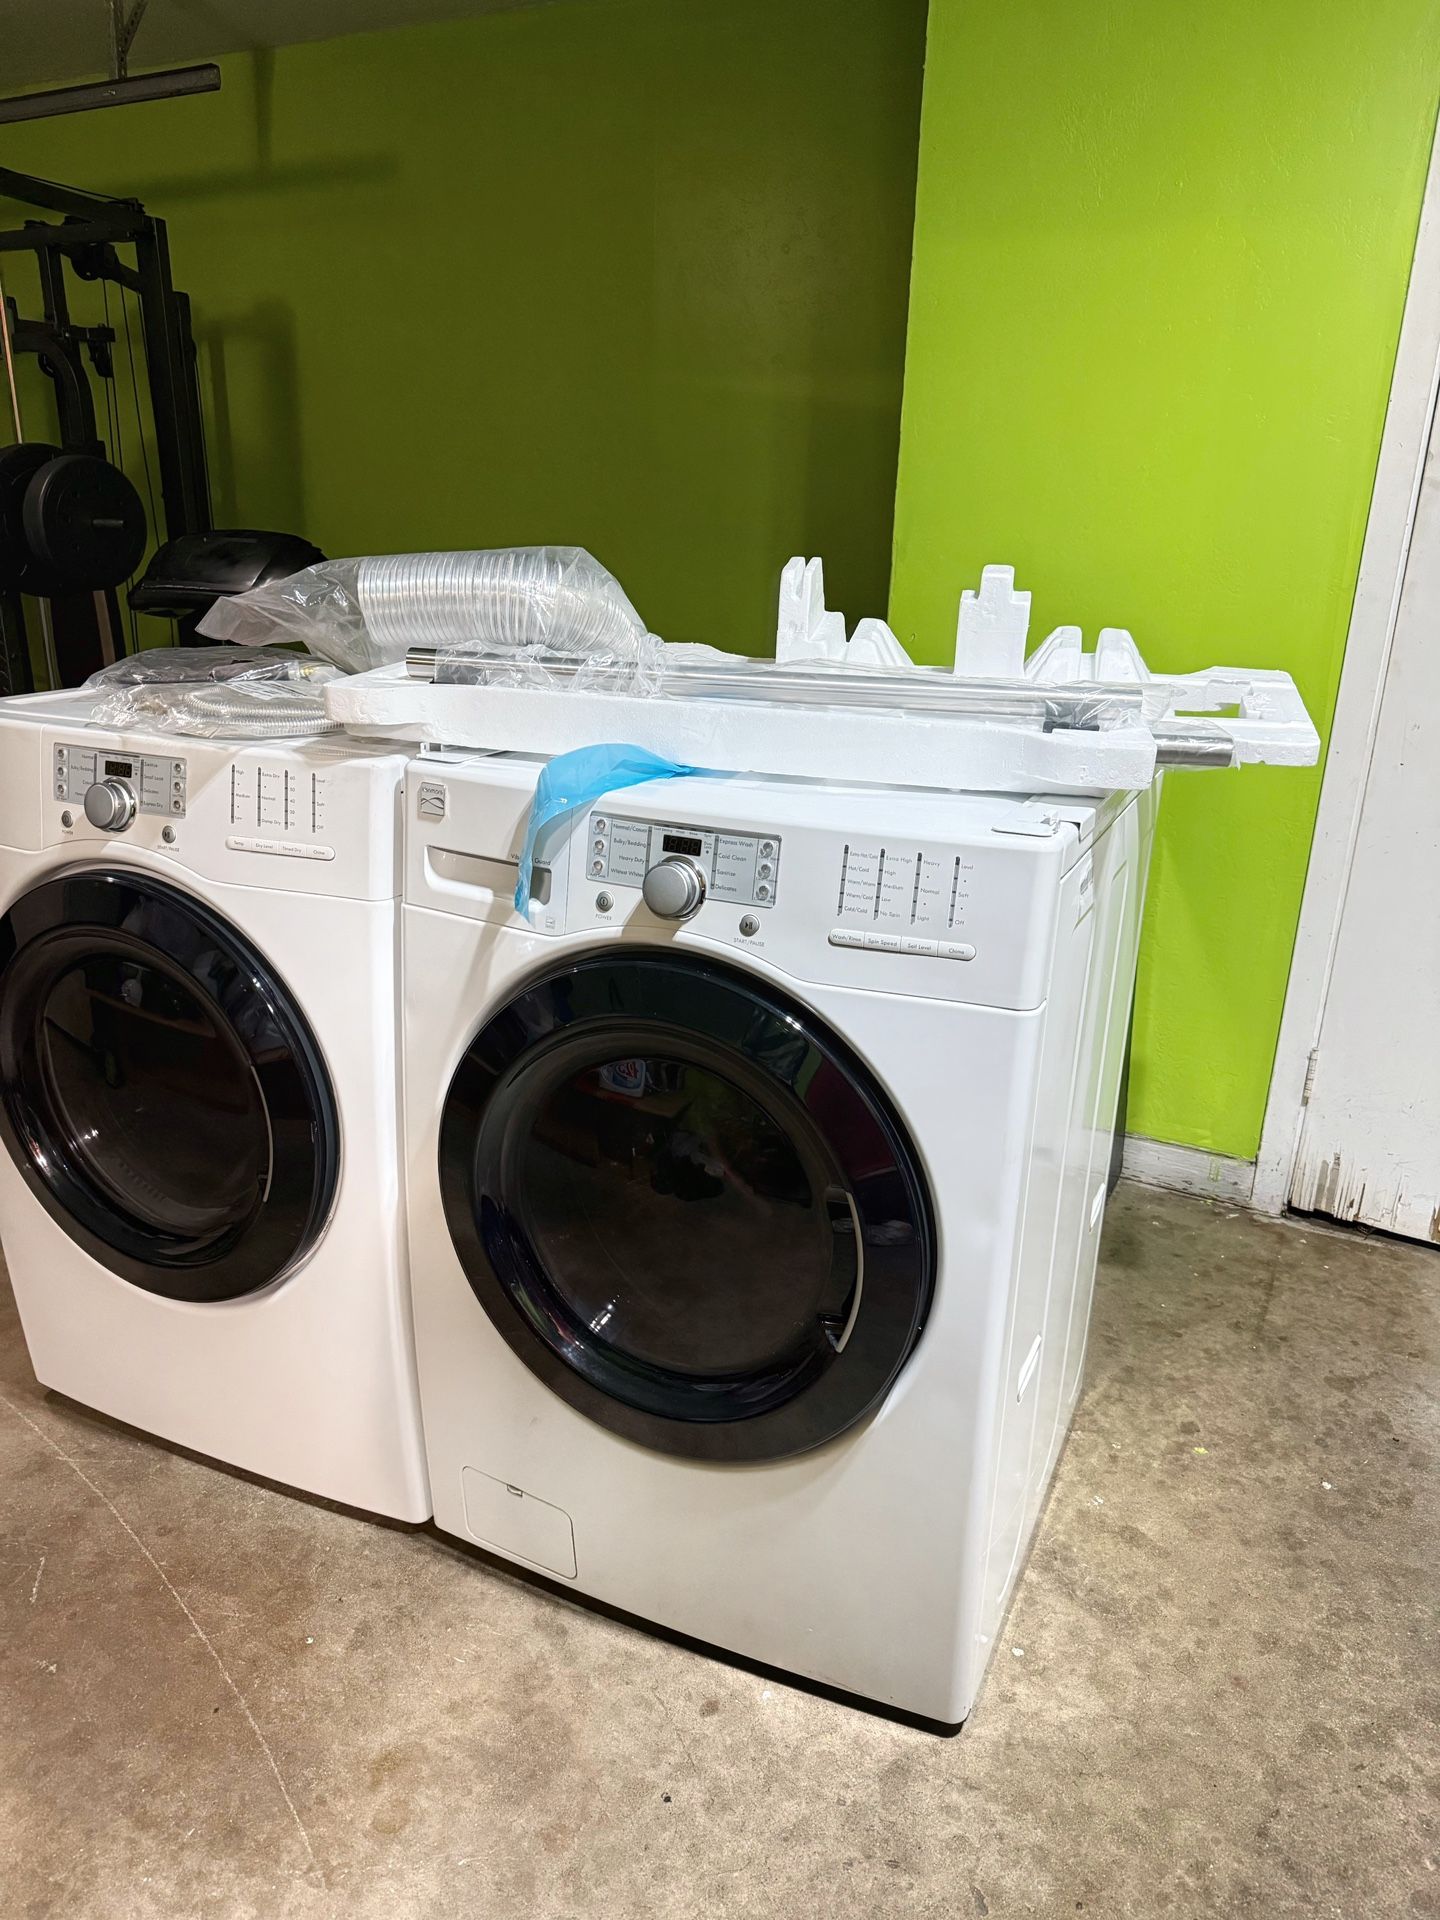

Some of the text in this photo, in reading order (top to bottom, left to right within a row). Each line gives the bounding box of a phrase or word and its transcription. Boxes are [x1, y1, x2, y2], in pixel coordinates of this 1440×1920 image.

[719, 838, 738, 848] Express
[619, 855, 645, 865] Heavy Duty
[732, 854, 747, 862] Clean
[923, 859, 940, 868] Heavy
[715, 883, 737, 892] Delicates
[846, 892, 874, 901] Warm/Cold
[844, 906, 868, 914] Cold/Cold
[733, 937, 765, 947] START/PAUSE
[832, 934, 862, 942] Wash/Rinse
[881, 939, 898, 947] Speed
